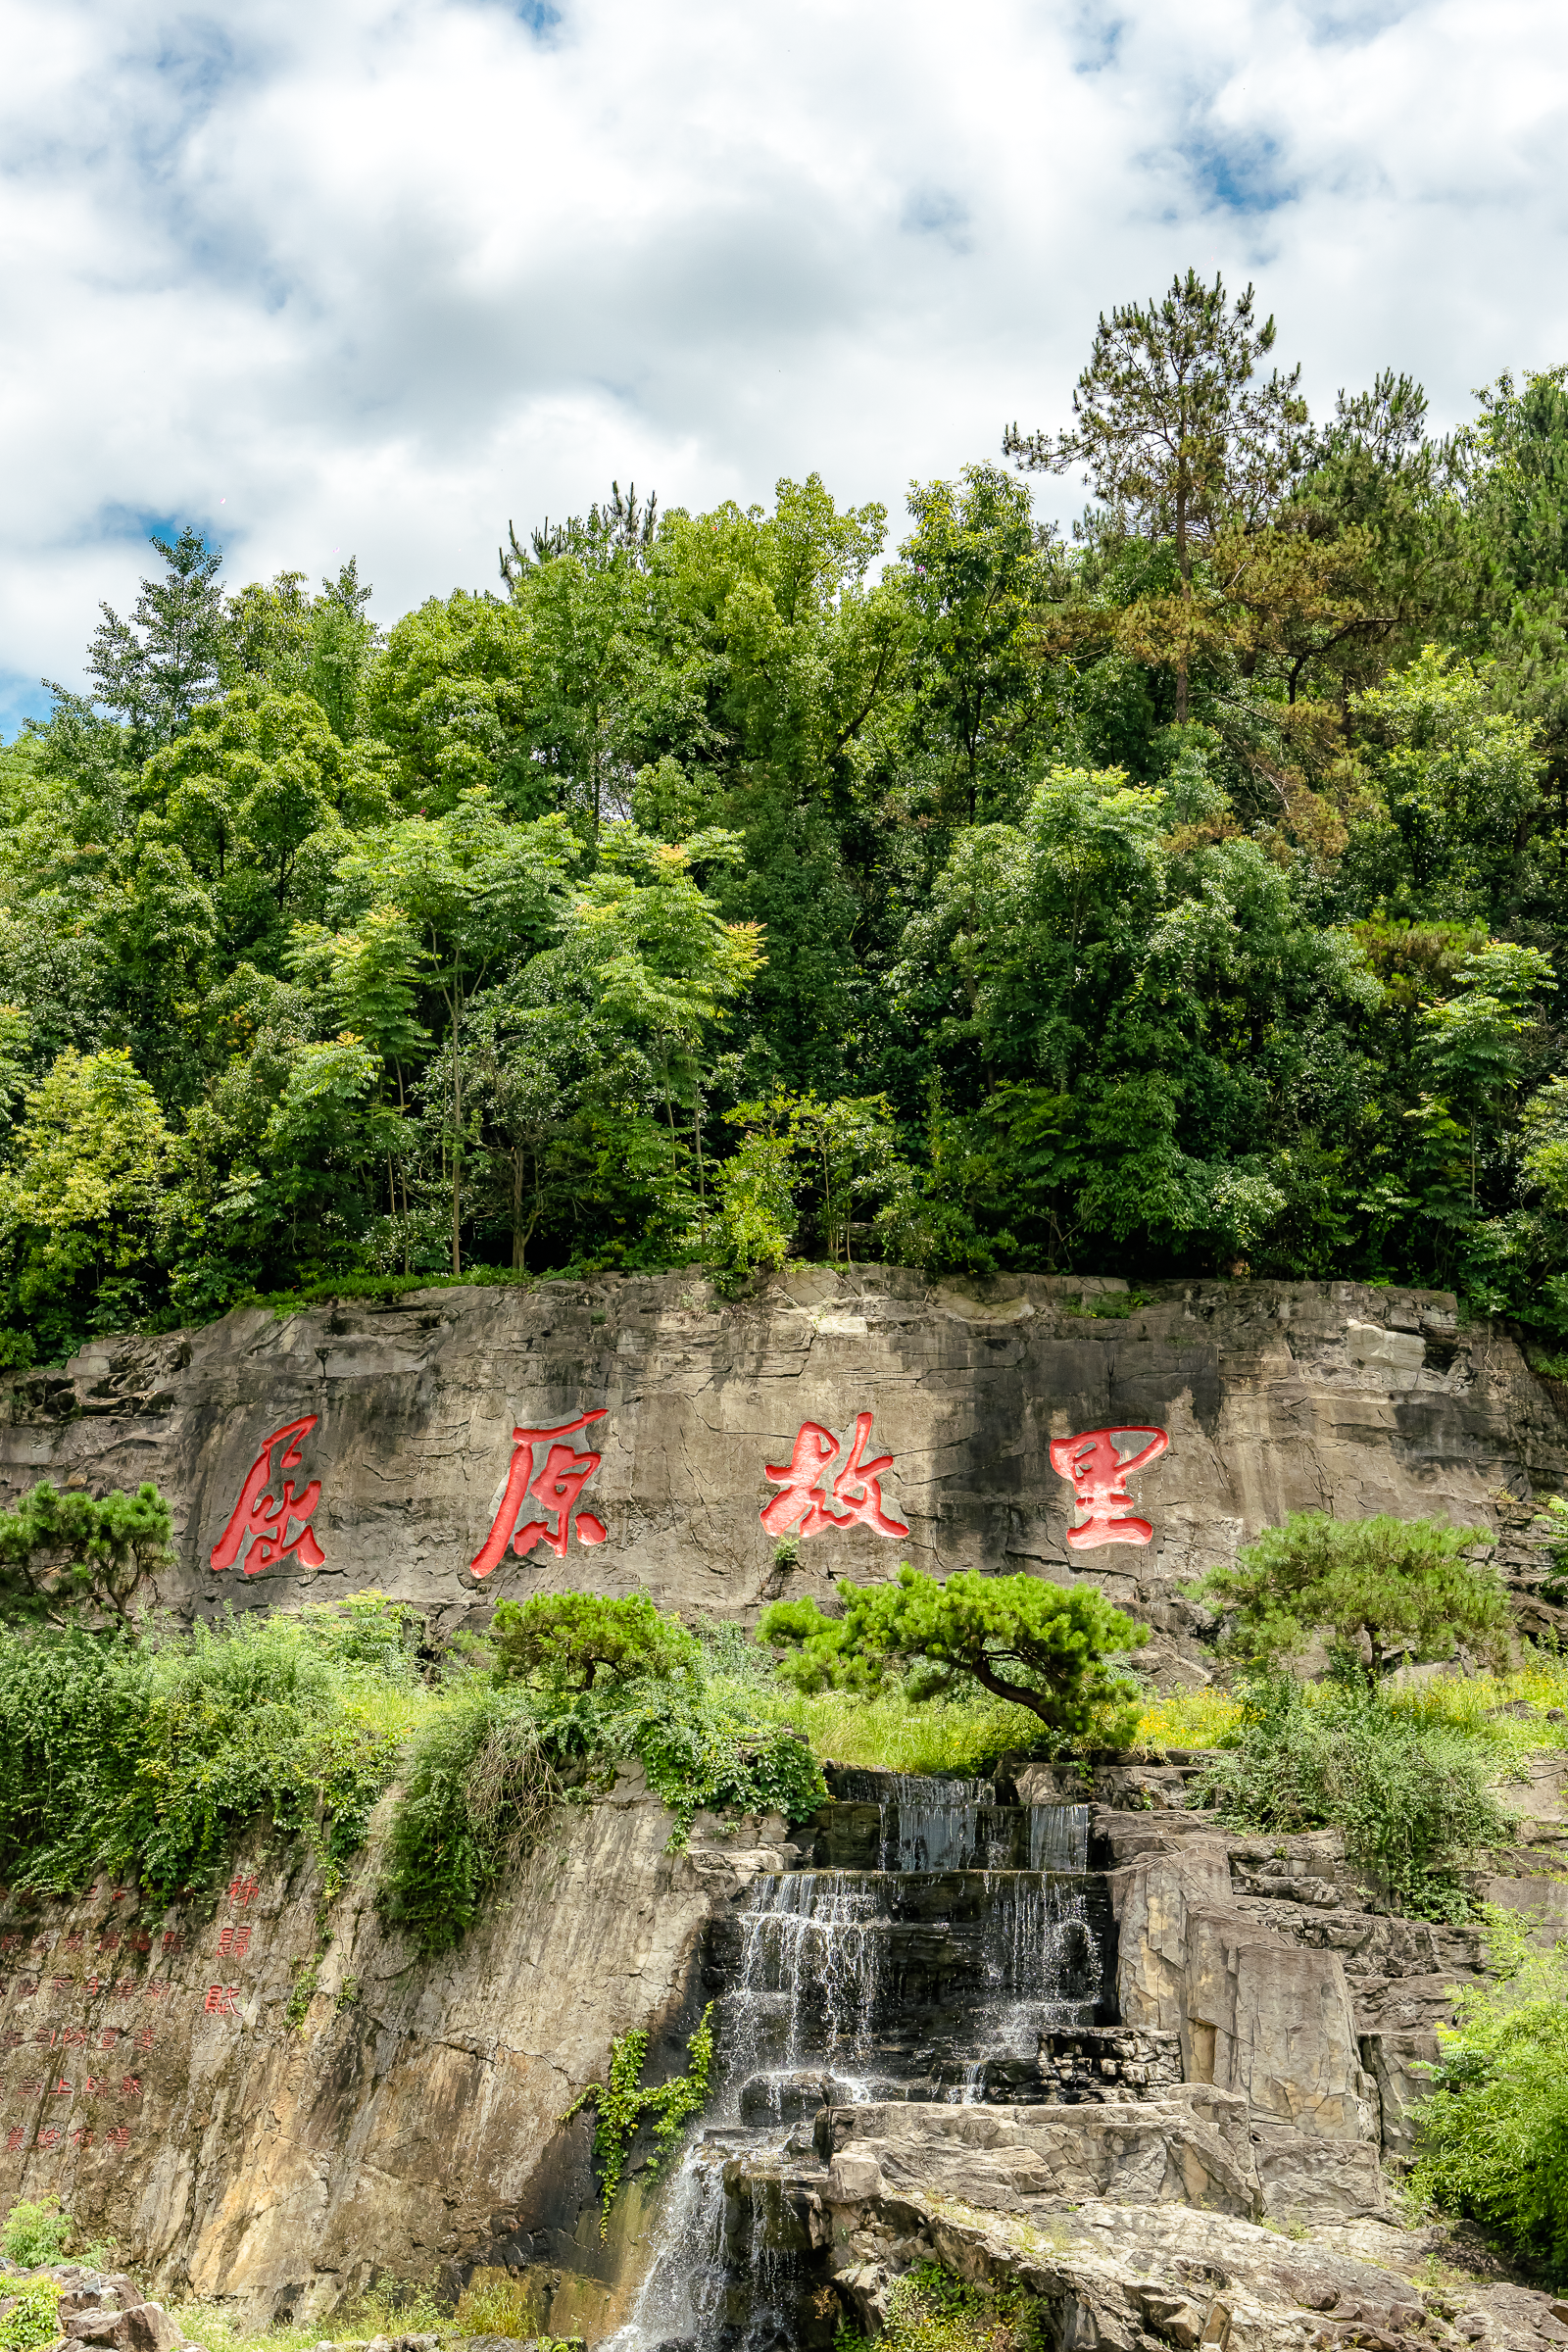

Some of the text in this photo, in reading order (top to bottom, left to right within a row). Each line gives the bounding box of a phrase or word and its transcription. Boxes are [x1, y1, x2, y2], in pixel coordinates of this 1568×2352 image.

[211, 1409, 1169, 1579] 屈原故里
[204, 1874, 259, 2017] 秭歸賦
